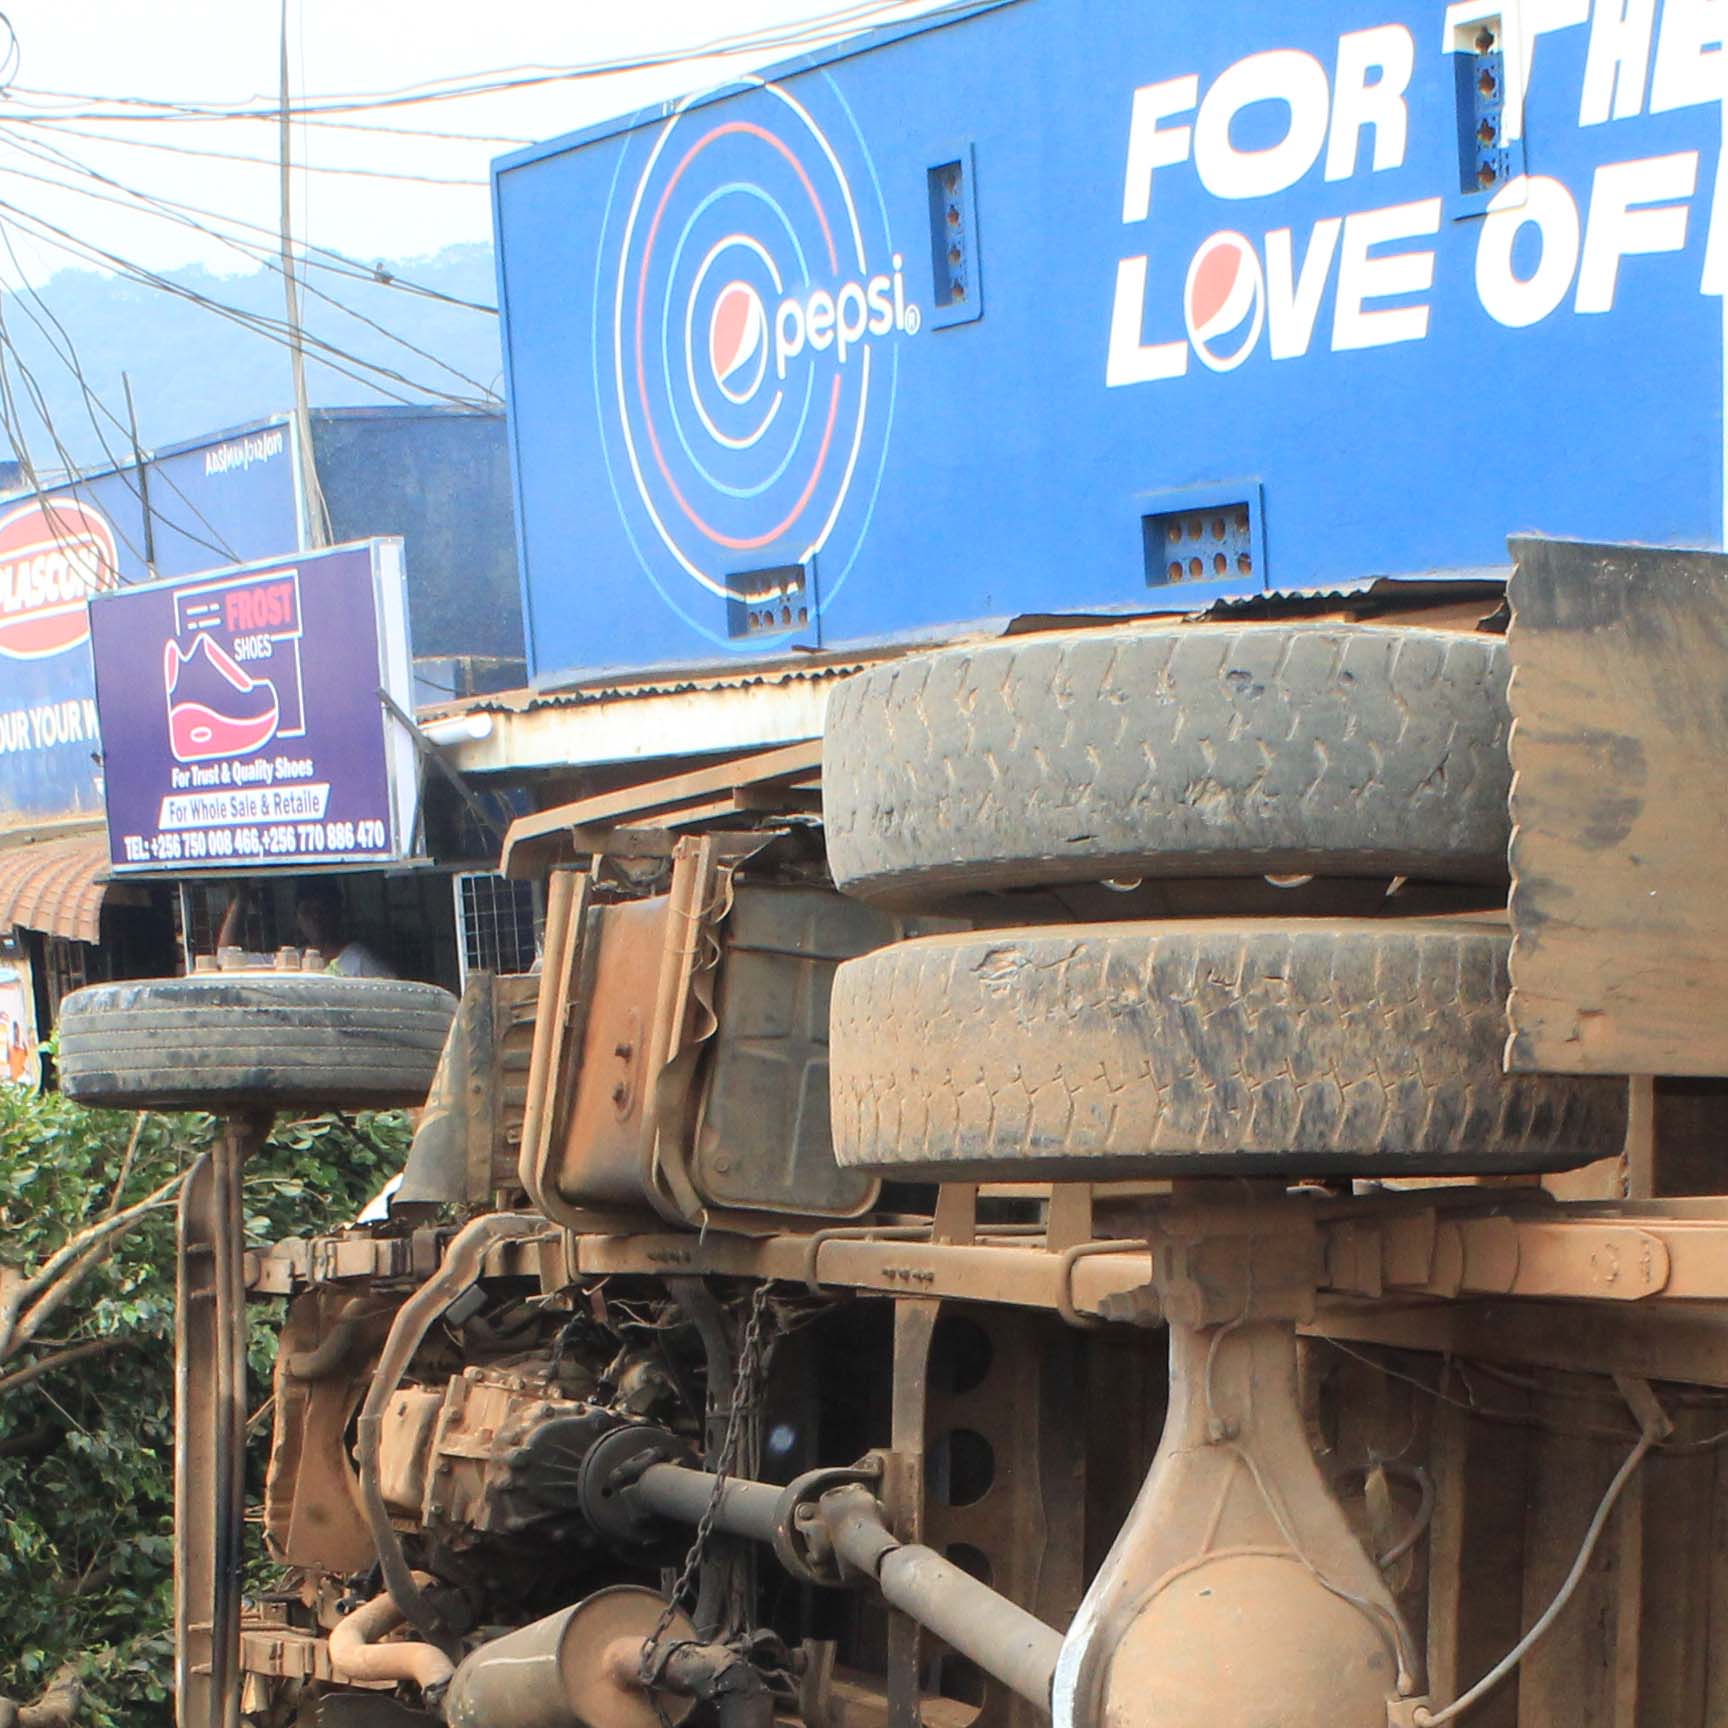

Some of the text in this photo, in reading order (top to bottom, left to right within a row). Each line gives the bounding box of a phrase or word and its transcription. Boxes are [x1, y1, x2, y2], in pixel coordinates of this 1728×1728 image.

[1122, 23, 1415, 223] FOR
[1107, 198, 1442, 388] LOVE
[1475, 150, 1700, 328] OF
[776, 254, 905, 380] pepsi
[225, 582, 293, 632] FROST
[234, 634, 272, 661] SHOES
[31, 700, 87, 747] YOUR
[172, 757, 313, 788] For Trust & Quality Shoes
[170, 793, 320, 822] For Whole Sale & Retaile
[124, 836, 150, 861] TEL:
[151, 832, 181, 859] +256
[182, 831, 206, 857] 750
[208, 830, 233, 856] 008
[298, 824, 324, 851] 770
[326, 822, 354, 849] 886
[357, 820, 385, 848] 470
